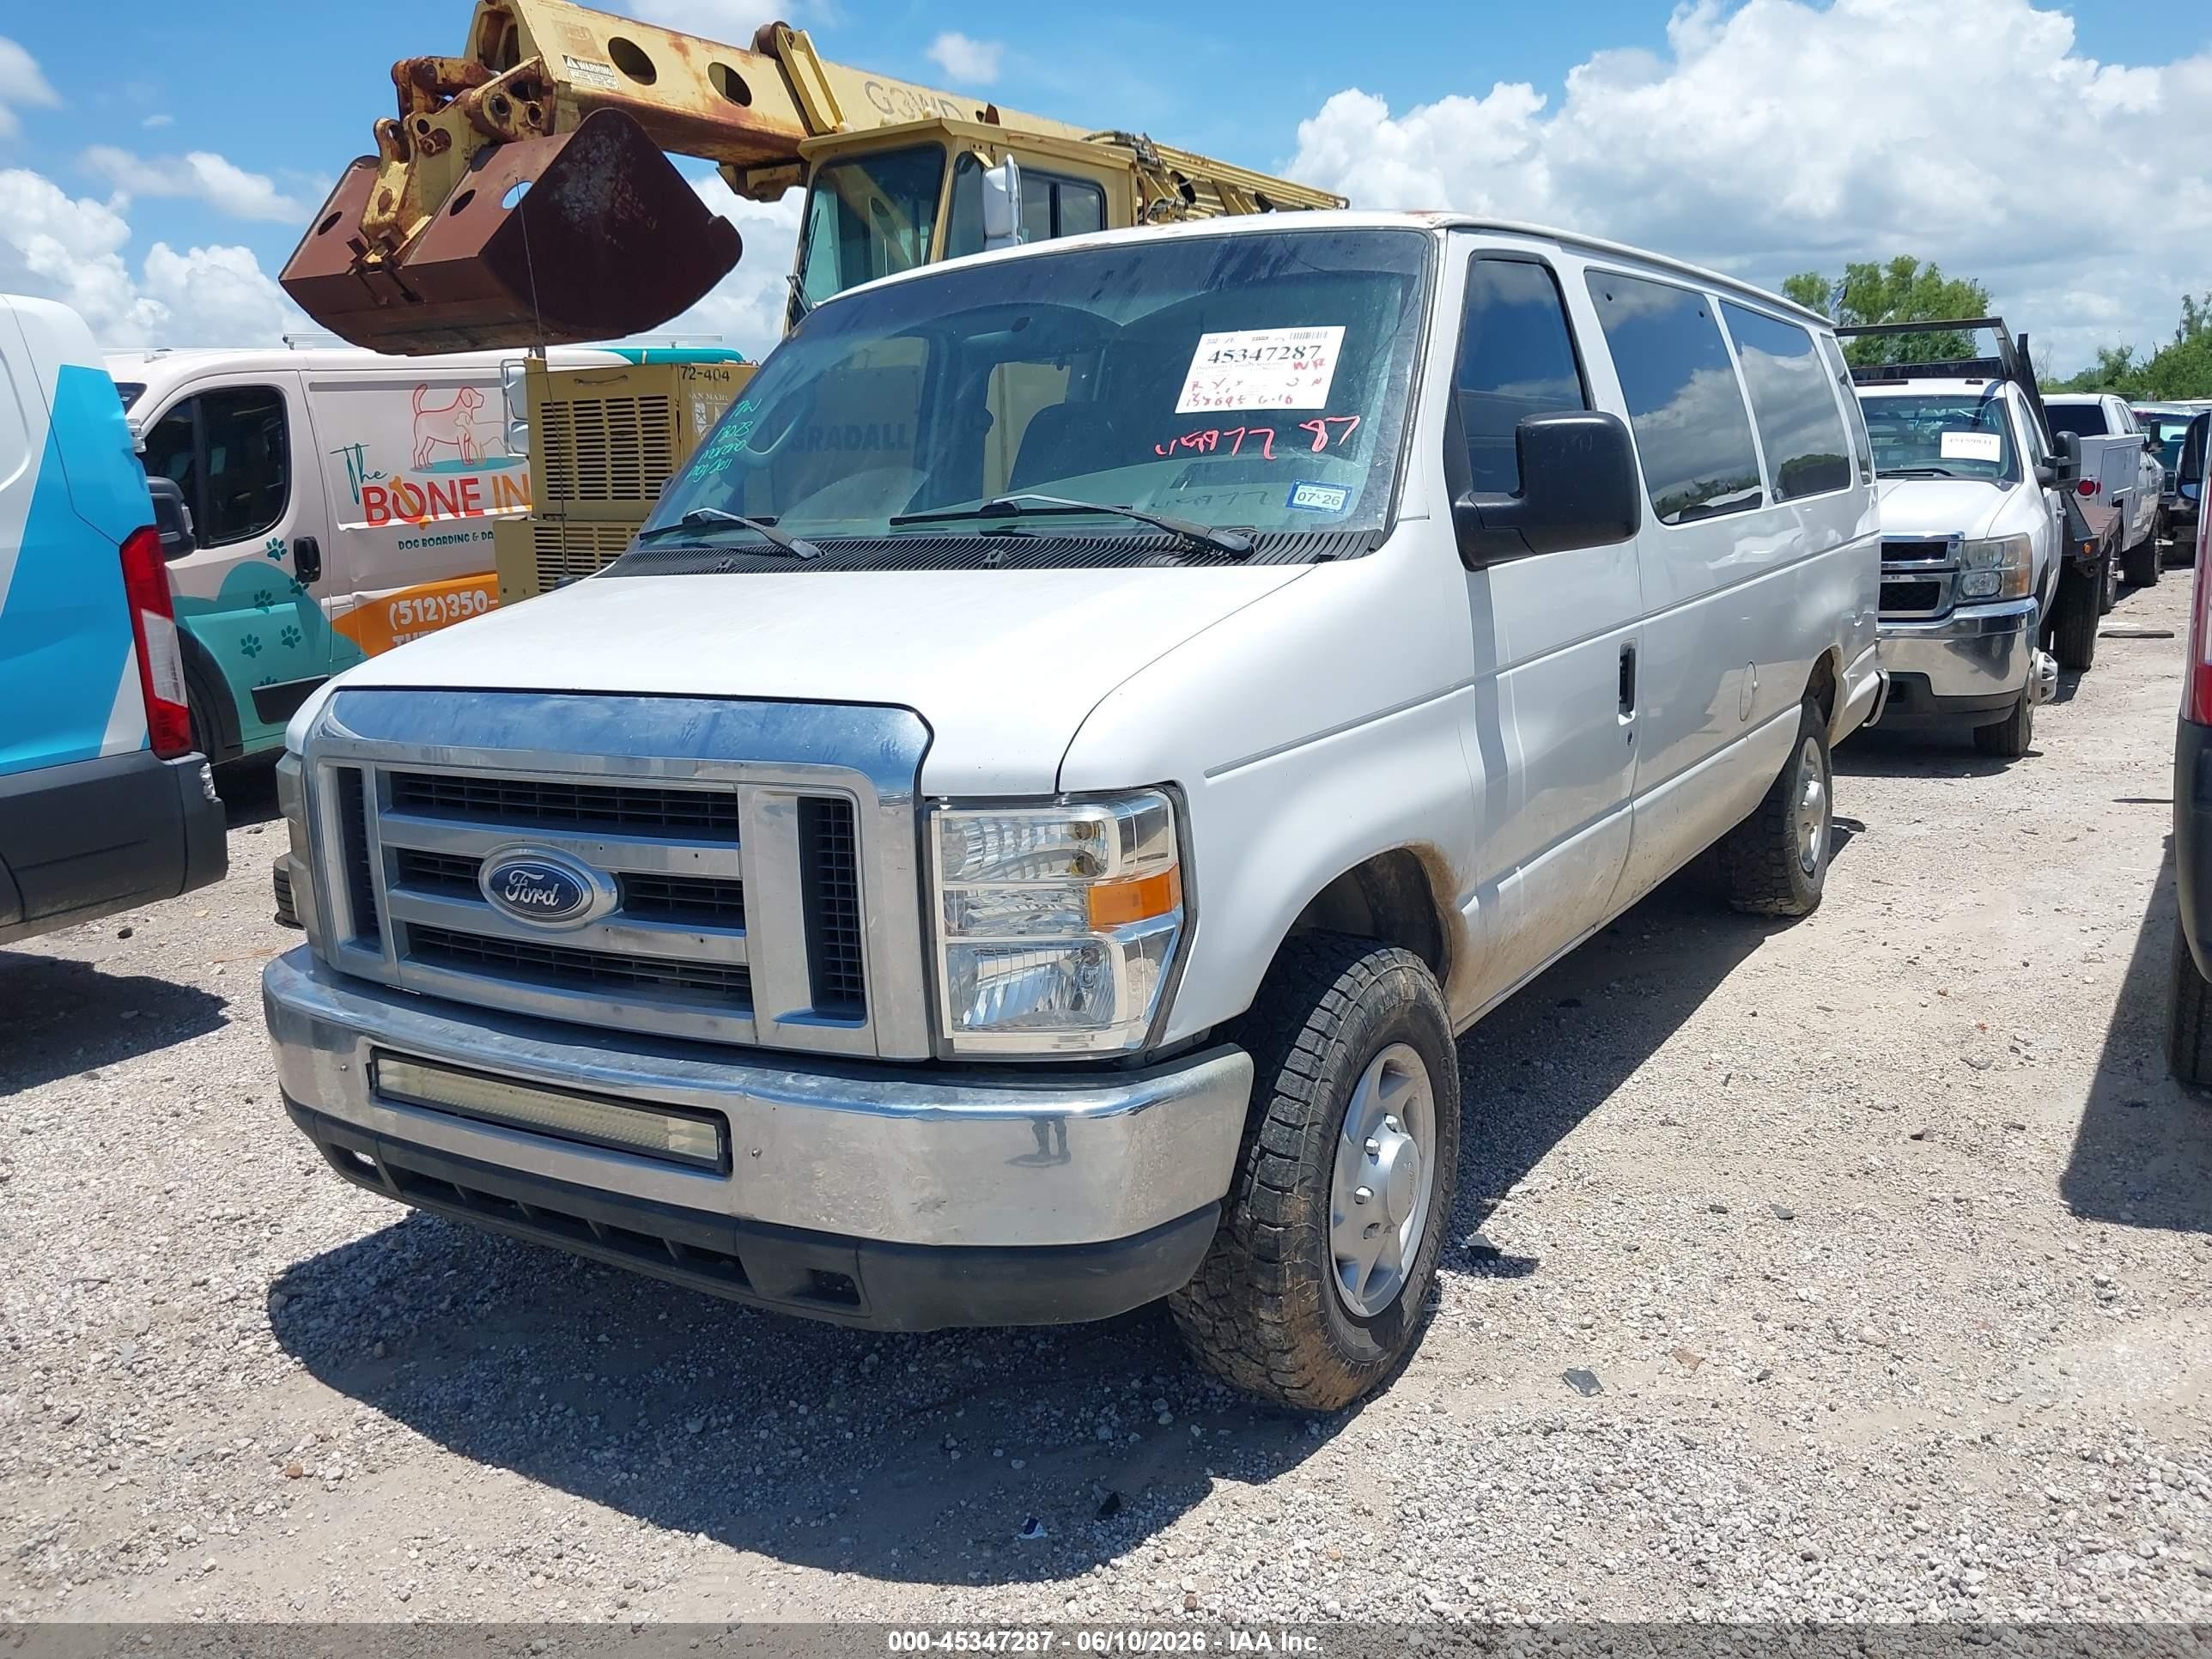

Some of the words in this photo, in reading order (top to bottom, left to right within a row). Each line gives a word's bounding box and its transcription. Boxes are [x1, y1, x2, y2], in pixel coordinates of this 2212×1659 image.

[1207, 344, 1322, 363] 45347287
[680, 365, 730, 382] 72-404
[790, 422, 909, 453] GRADALL
[330, 443, 388, 505] The
[362, 476, 484, 527] BONE
[491, 473, 532, 514] IN
[398, 539, 420, 550] DOG
[422, 532, 470, 547] BOARDING
[472, 532, 479, 542] &
[505, 869, 560, 907] Ford
